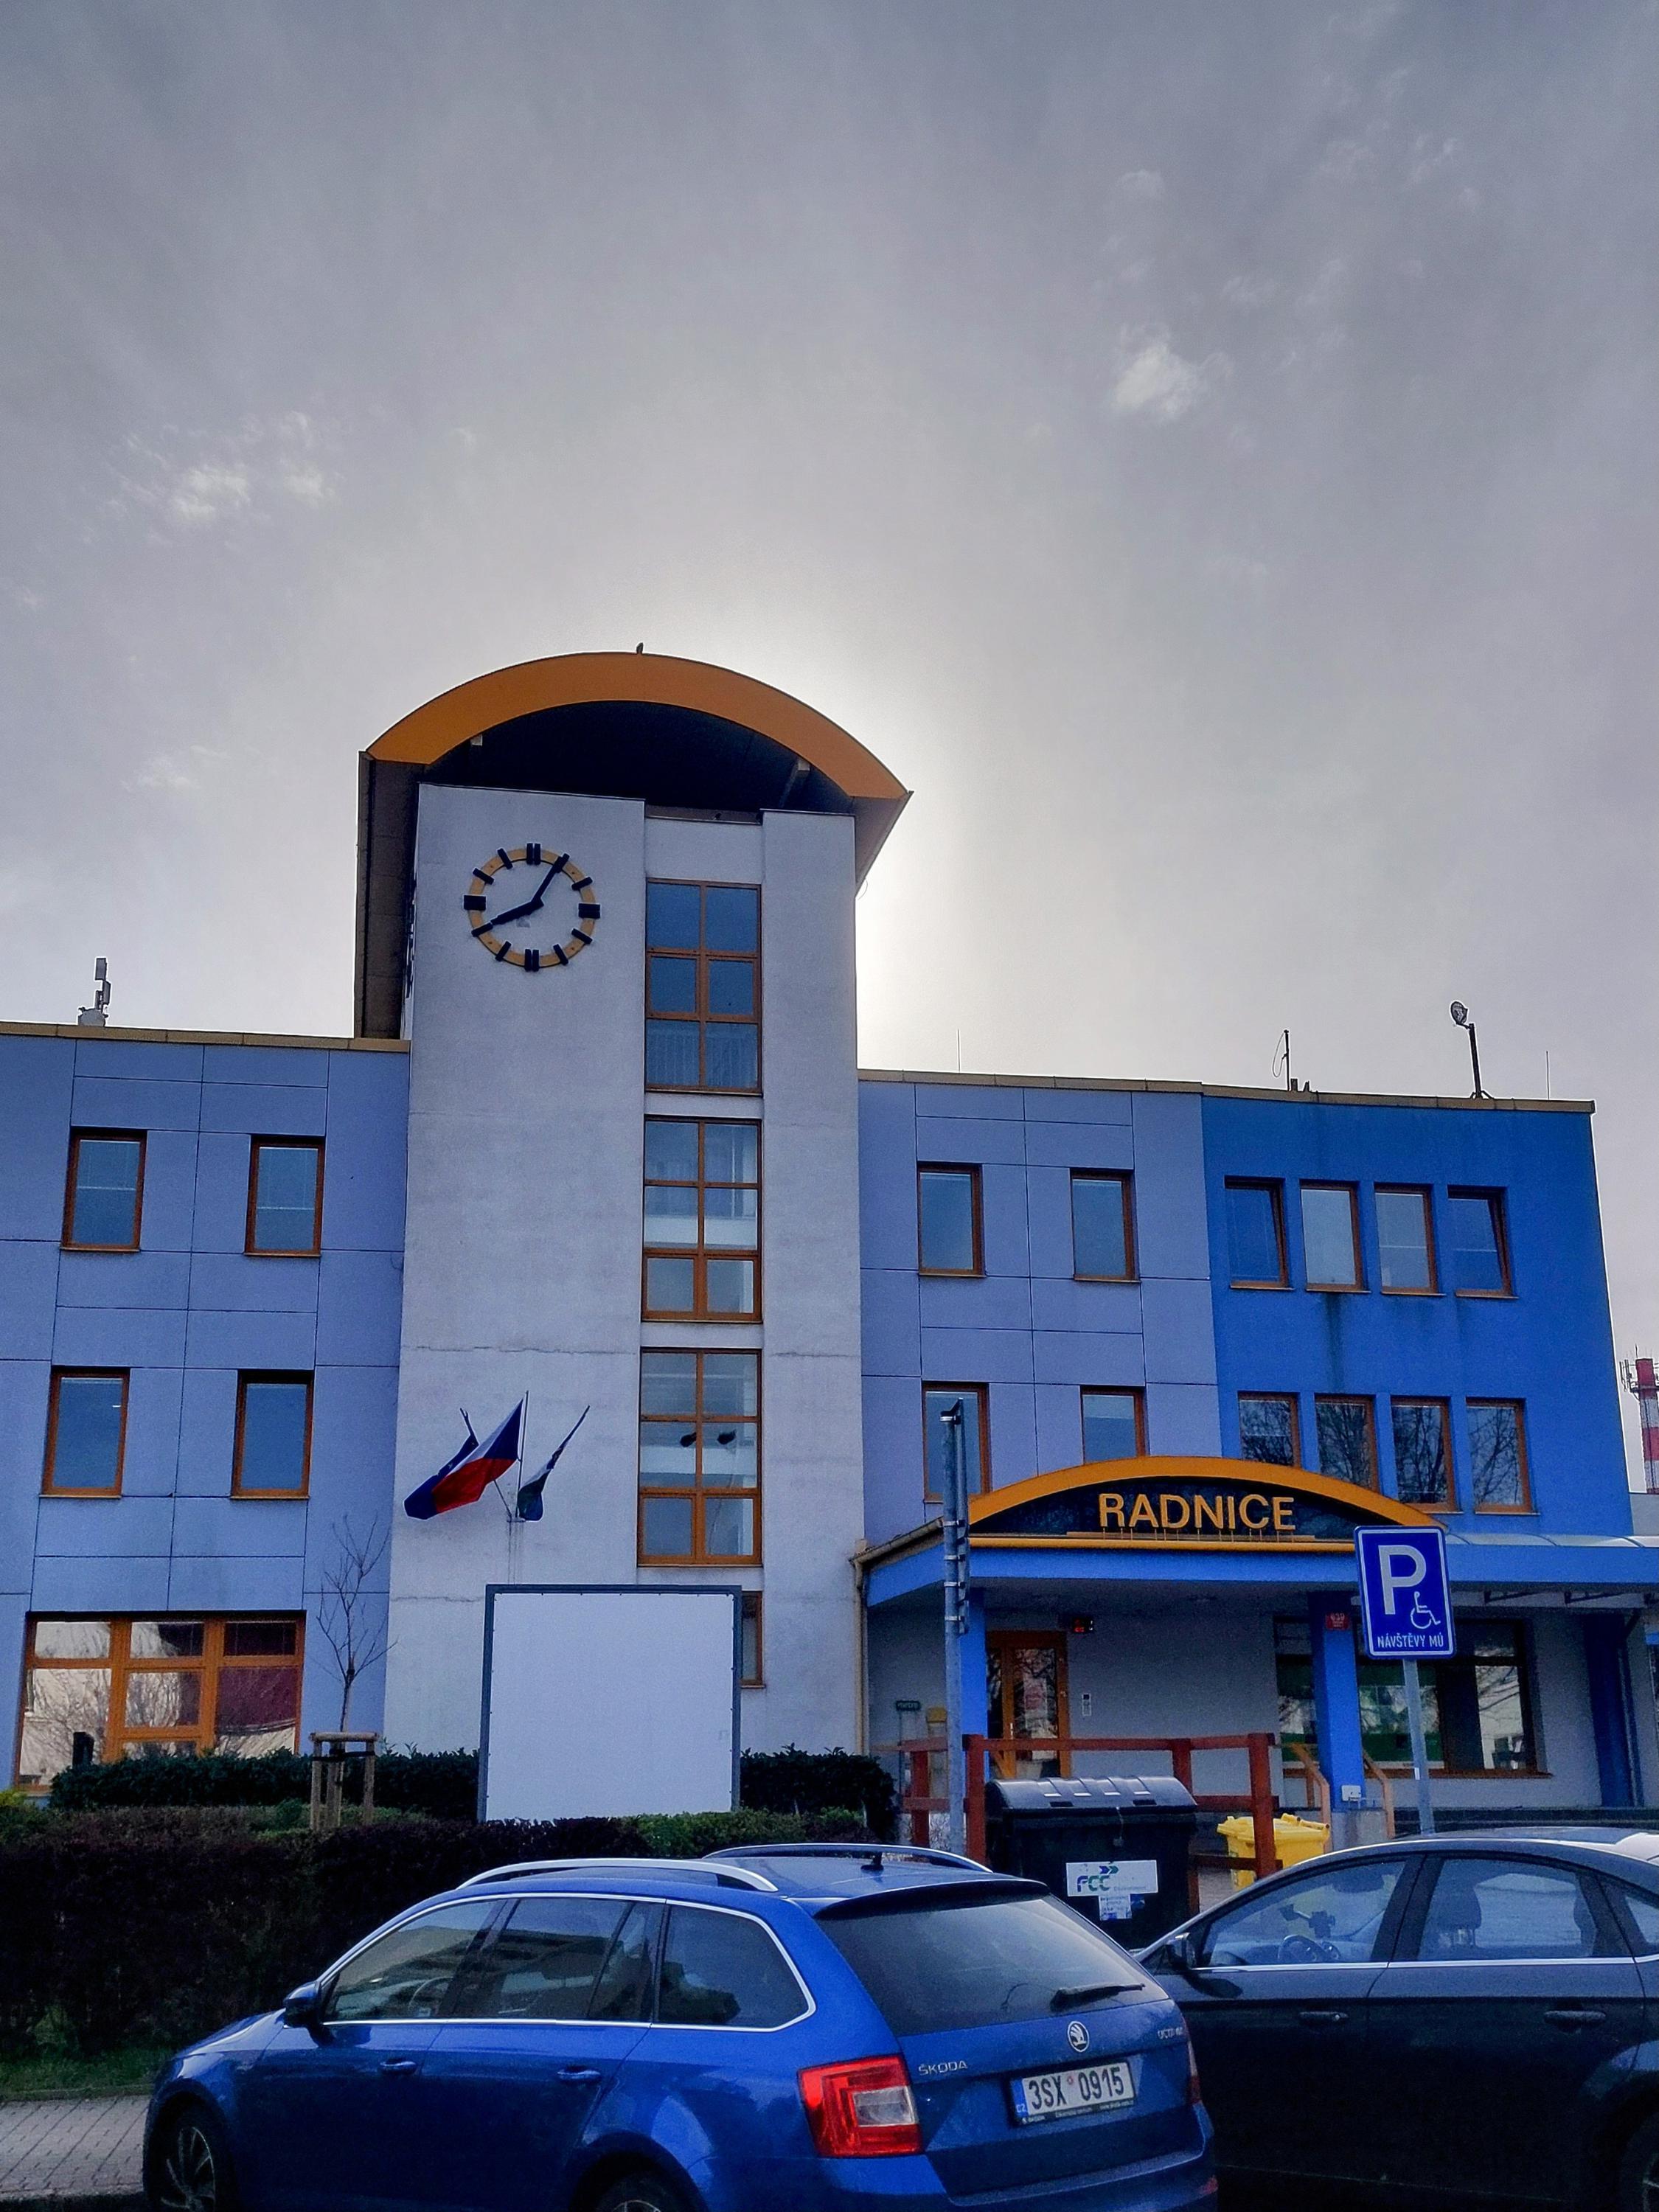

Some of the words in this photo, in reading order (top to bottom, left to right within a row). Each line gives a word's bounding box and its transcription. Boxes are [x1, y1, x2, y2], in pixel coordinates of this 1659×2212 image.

[1099, 1493, 1295, 1530] RADNICE
[1378, 1545, 1427, 1615] P
[1377, 1632, 1426, 1648] NÁVŠTĚVY
[1429, 1632, 1444, 1648] MÚ
[1077, 1875, 1110, 1892] FCC
[919, 2060, 968, 2076] ŠKODA
[1028, 2075, 1067, 2110] 3SX
[1077, 2066, 1124, 2101] 0915
[1015, 2103, 1027, 2113] CZ
